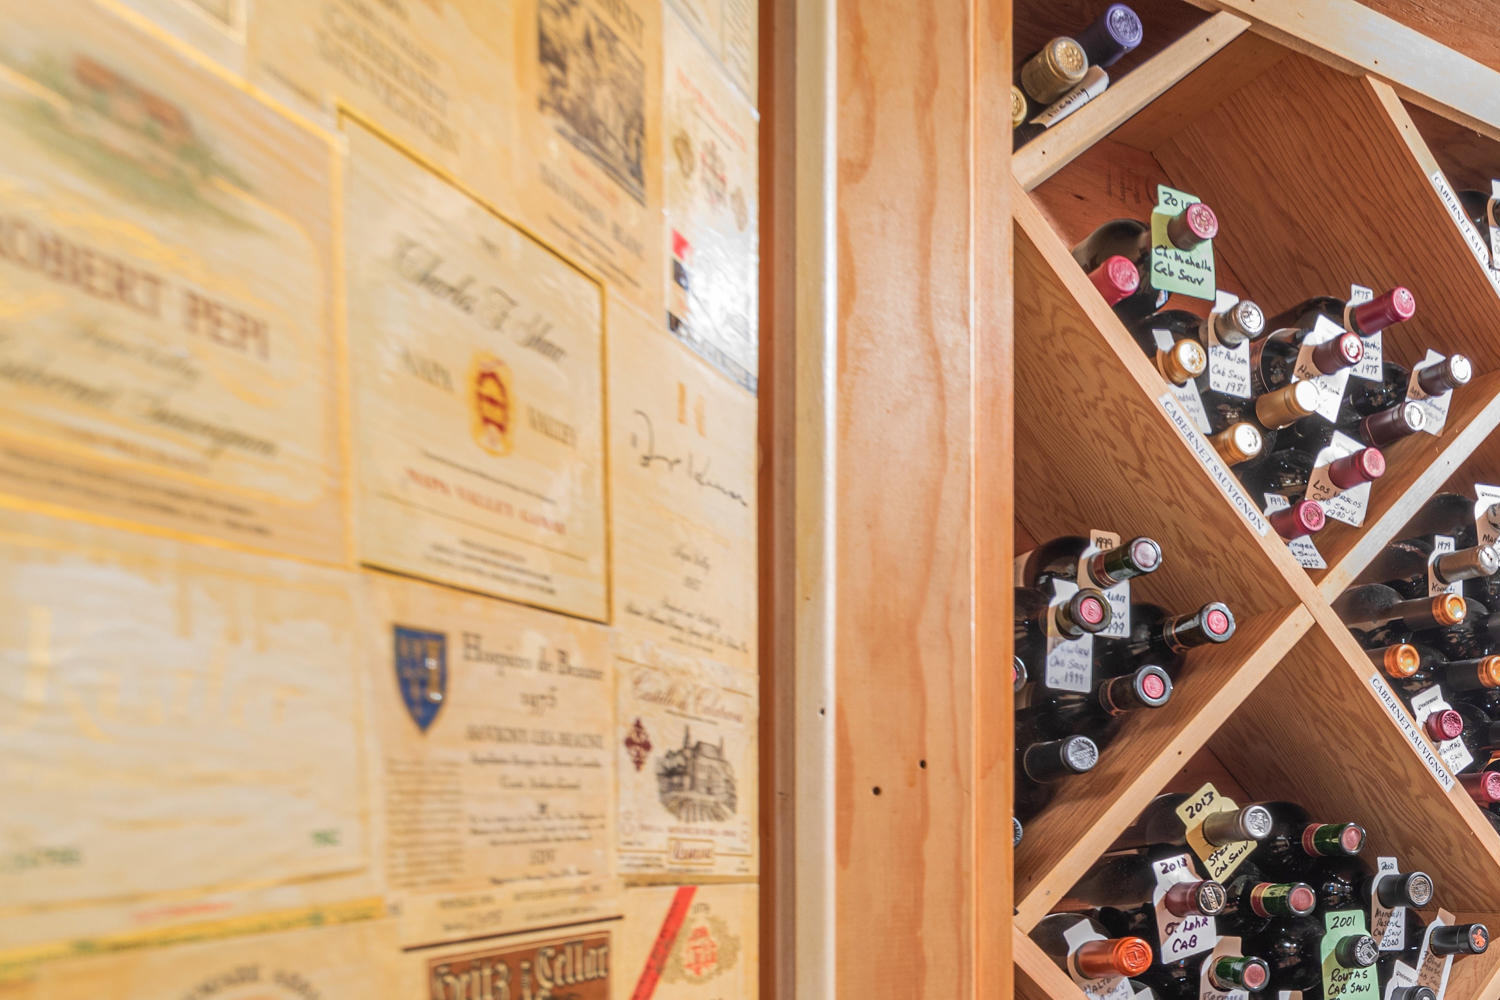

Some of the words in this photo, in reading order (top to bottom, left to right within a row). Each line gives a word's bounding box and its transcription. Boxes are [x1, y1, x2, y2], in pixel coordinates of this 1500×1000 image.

[1434, 175, 1470, 230] CABERNET
[0, 216, 161, 320] OBERT
[1162, 398, 1214, 464] CABERNET
[1210, 458, 1267, 533] SAUVIGNON
[1372, 678, 1412, 731] CABERNET
[1408, 727, 1451, 786] SAUVIGNON
[1185, 791, 1216, 819] 2013
[1171, 934, 1199, 954] CAB
[1330, 915, 1356, 930] 2001
